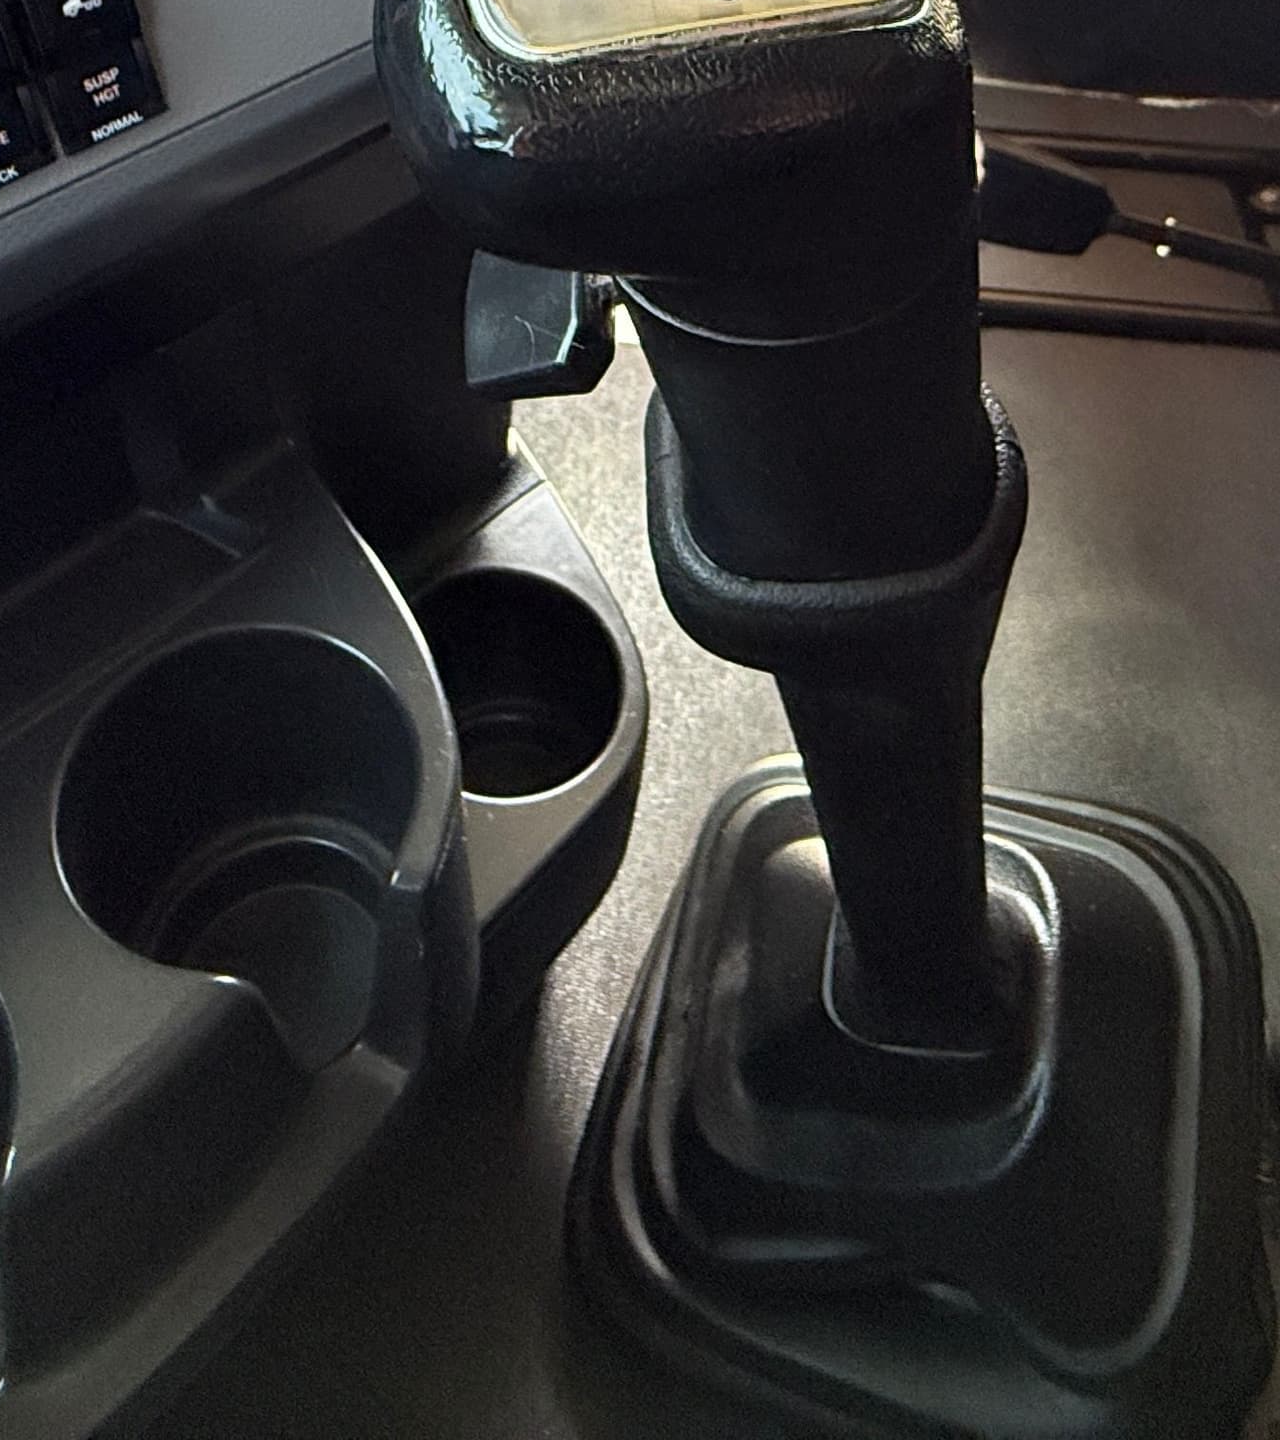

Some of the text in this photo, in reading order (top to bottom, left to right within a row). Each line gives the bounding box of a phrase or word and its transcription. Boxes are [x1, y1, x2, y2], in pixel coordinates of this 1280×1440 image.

[82, 67, 120, 93] SUSP
[92, 83, 121, 107] HGT
[91, 110, 144, 142] NORMAL
